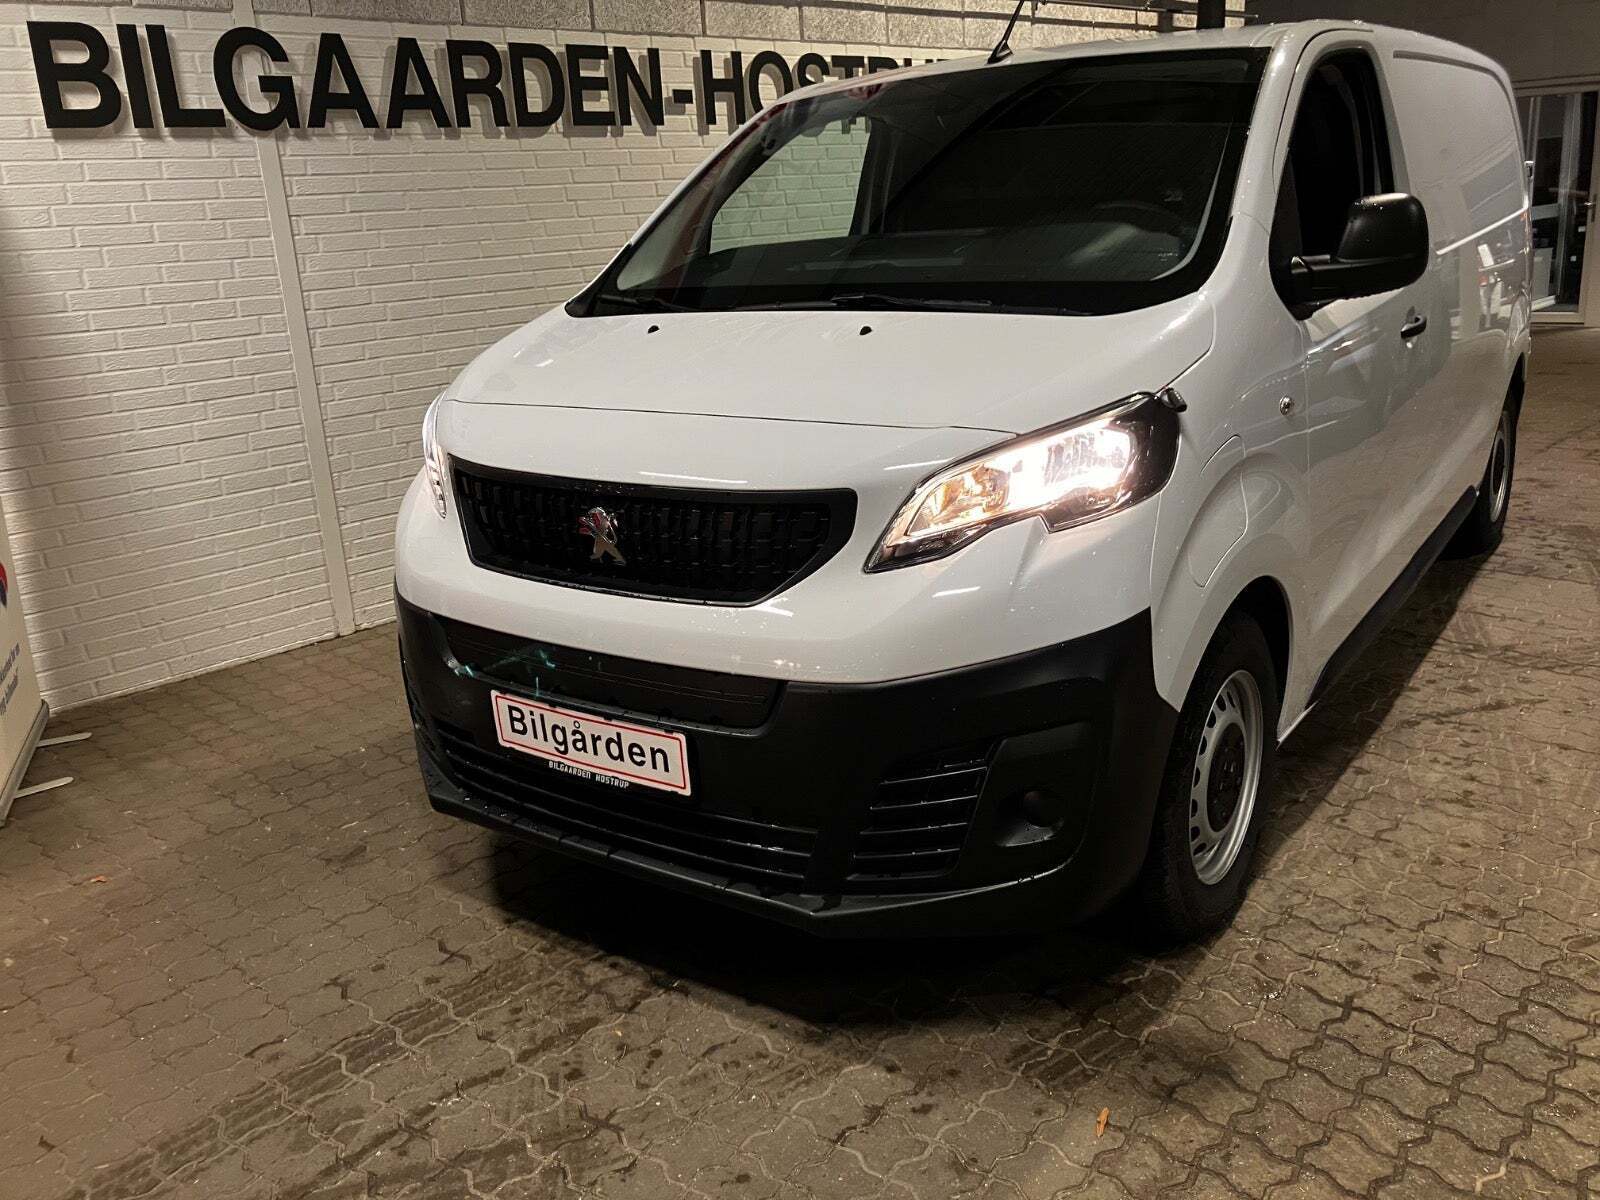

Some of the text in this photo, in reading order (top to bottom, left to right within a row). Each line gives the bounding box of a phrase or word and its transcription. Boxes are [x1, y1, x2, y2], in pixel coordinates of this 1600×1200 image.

[507, 705, 670, 773] Bilgården
[548, 760, 630, 788] BILGAARDEN HOSTRUP
